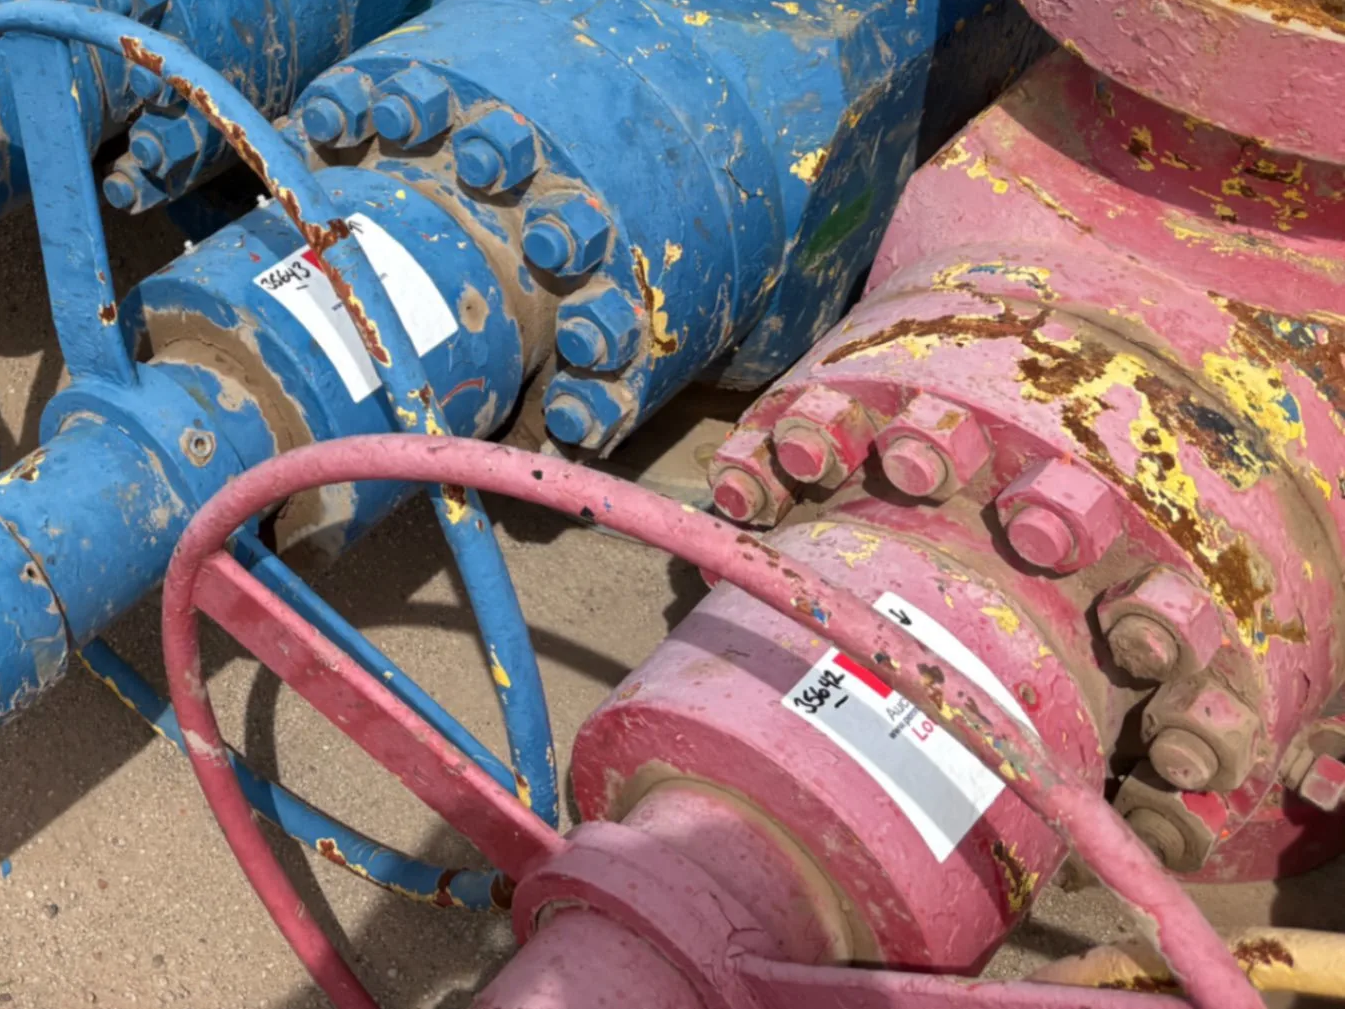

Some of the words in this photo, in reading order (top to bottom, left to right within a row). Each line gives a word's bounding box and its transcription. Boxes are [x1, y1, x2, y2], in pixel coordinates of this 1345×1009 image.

[260, 260, 311, 291] 35643
[793, 669, 846, 714] 35642
[911, 720, 937, 742] Lo
